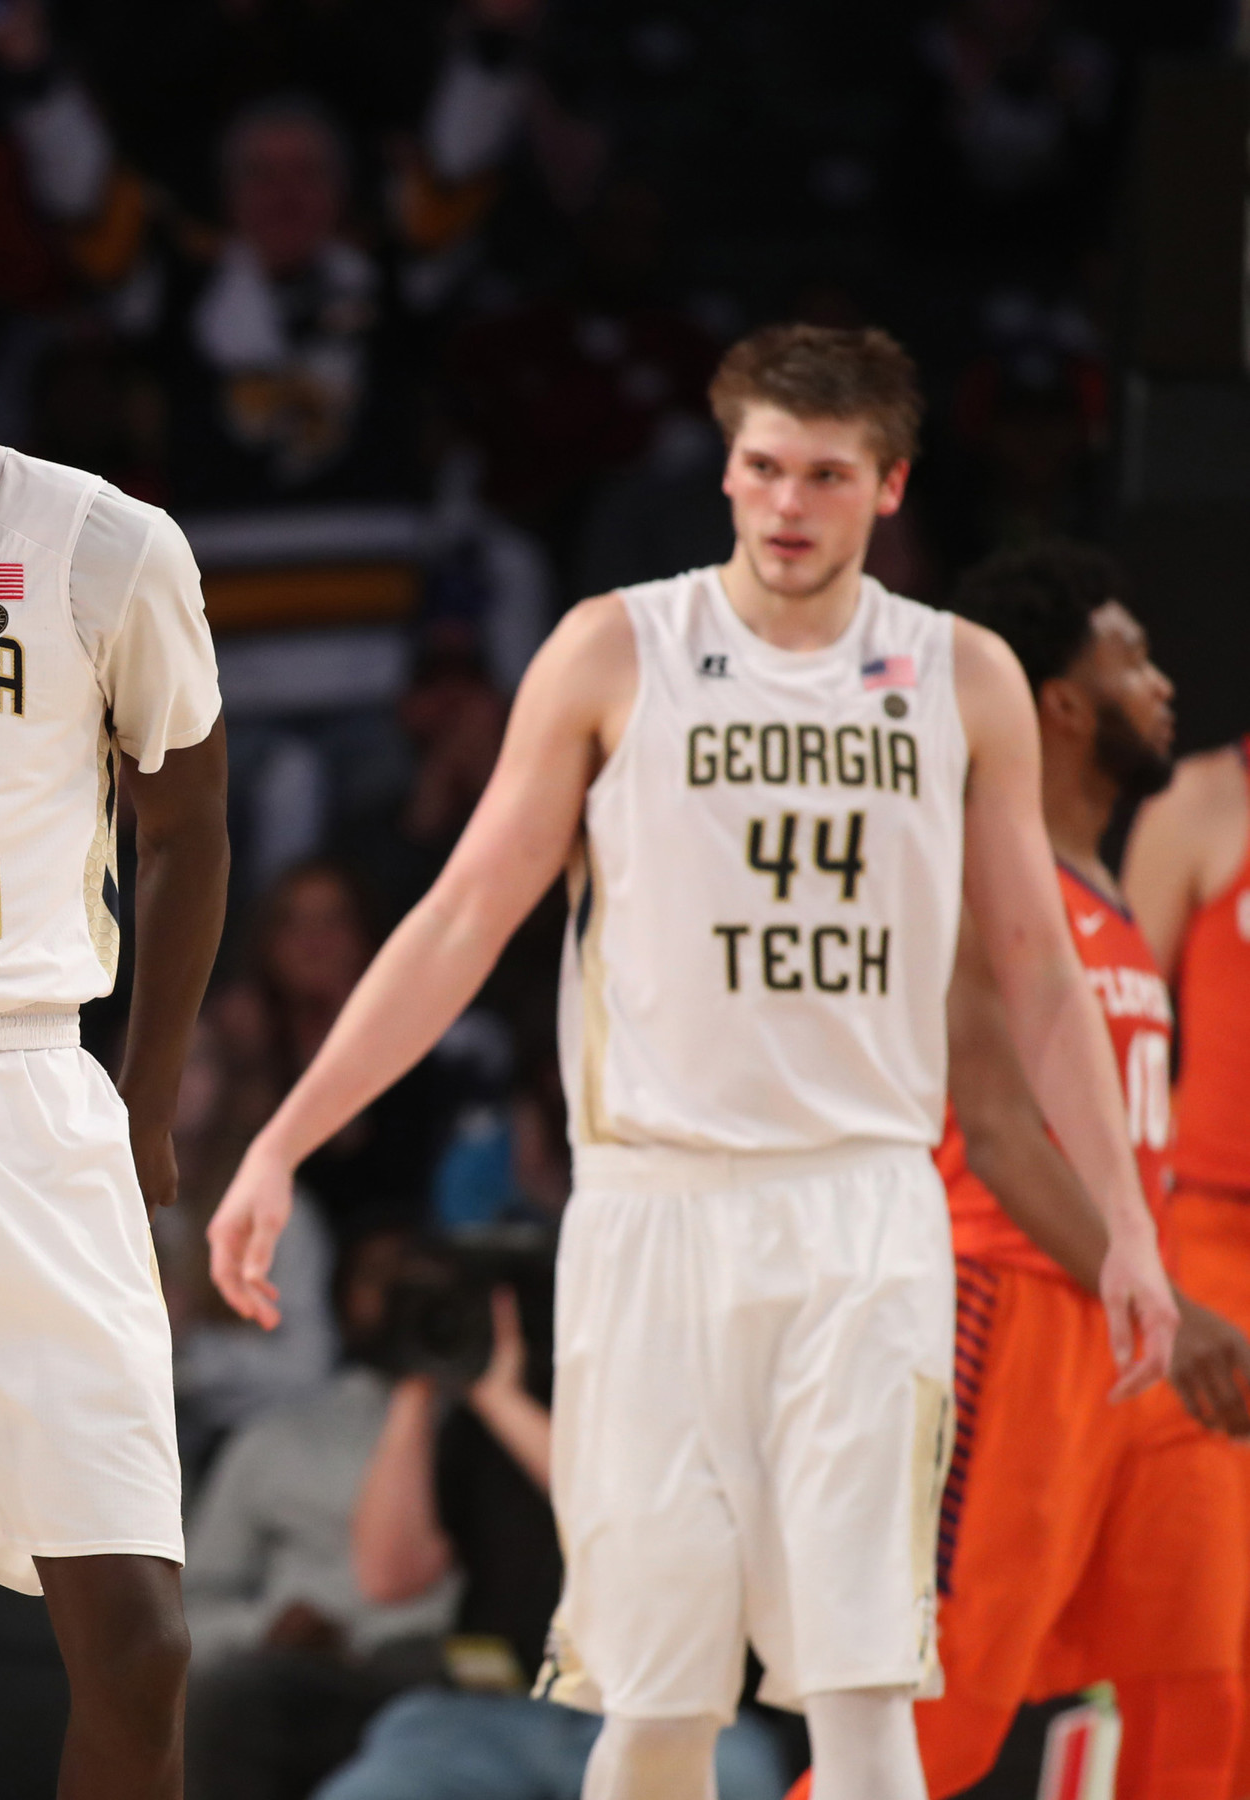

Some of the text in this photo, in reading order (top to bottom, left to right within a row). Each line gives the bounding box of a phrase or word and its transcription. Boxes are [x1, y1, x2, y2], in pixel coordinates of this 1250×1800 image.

[688, 722, 919, 800] GEORGIA
[746, 809, 865, 903] 44
[713, 924, 889, 995] TECH
